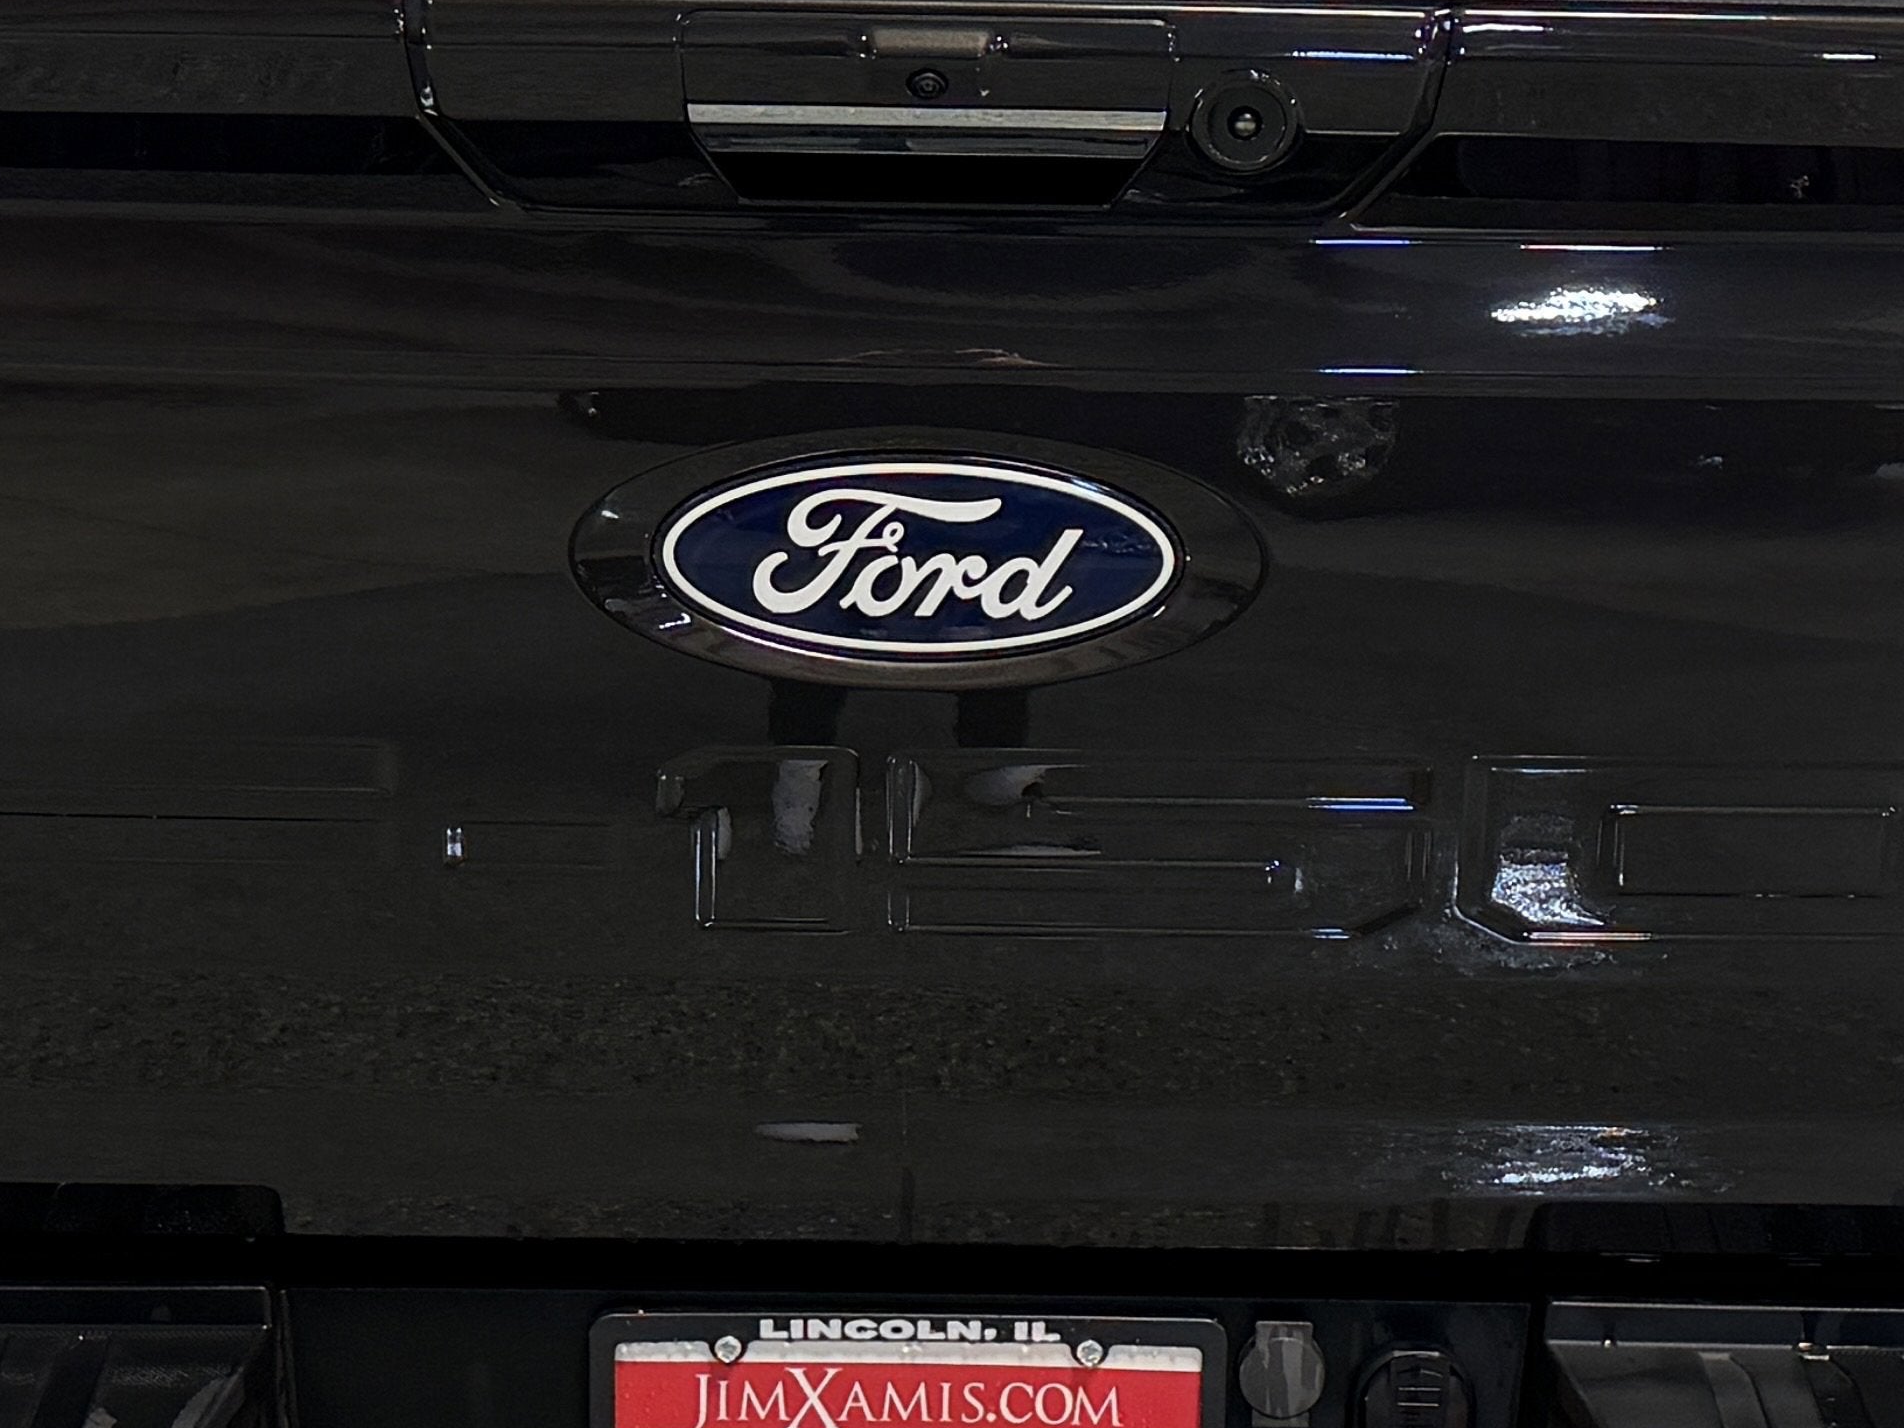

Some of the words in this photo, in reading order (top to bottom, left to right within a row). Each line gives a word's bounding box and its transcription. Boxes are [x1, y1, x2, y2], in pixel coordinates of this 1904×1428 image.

[752, 488, 1082, 621] Ford
[758, 1318, 998, 1342] LINCOLN,
[1013, 1320, 1062, 1343] IL
